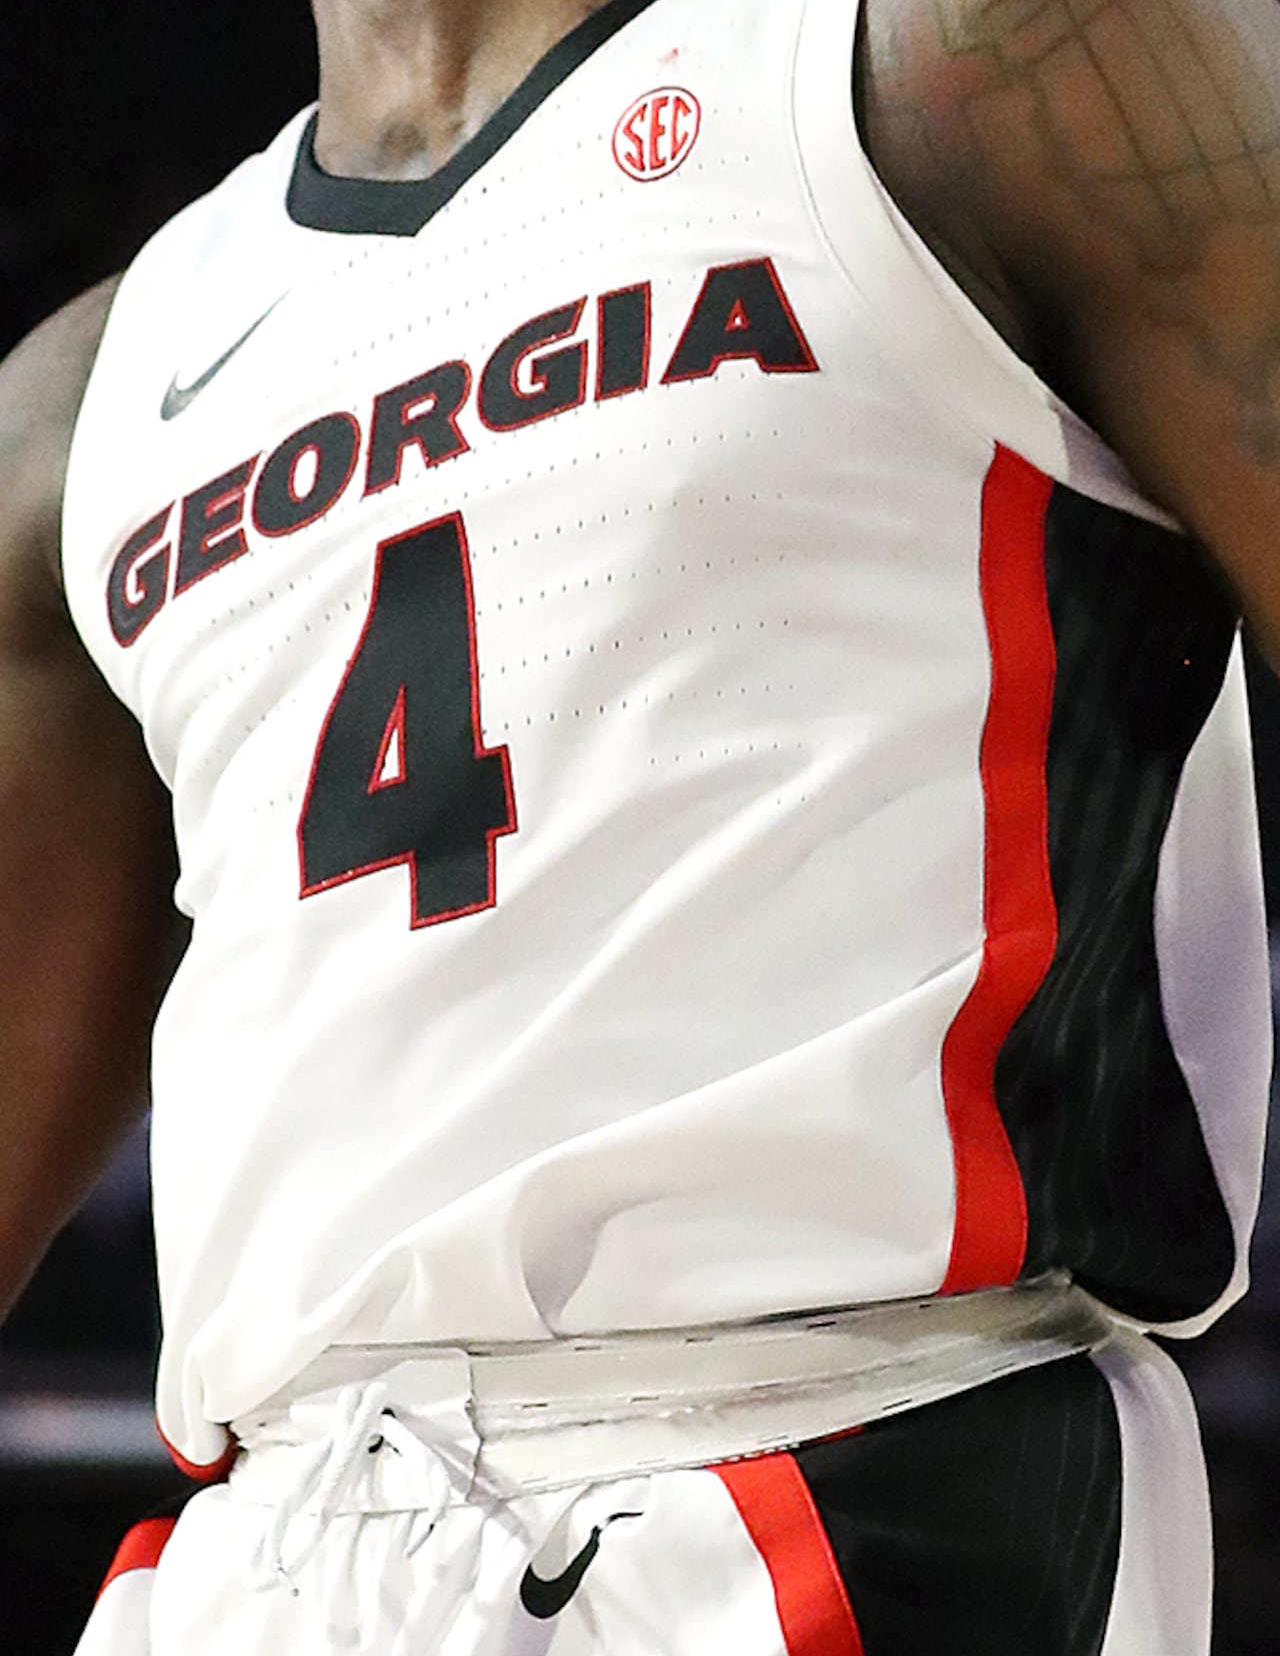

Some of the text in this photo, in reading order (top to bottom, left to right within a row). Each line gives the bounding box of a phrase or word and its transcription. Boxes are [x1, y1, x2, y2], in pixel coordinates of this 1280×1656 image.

[621, 94, 693, 173] SEC
[106, 256, 820, 648] GEORGIA
[297, 509, 518, 931] 4
